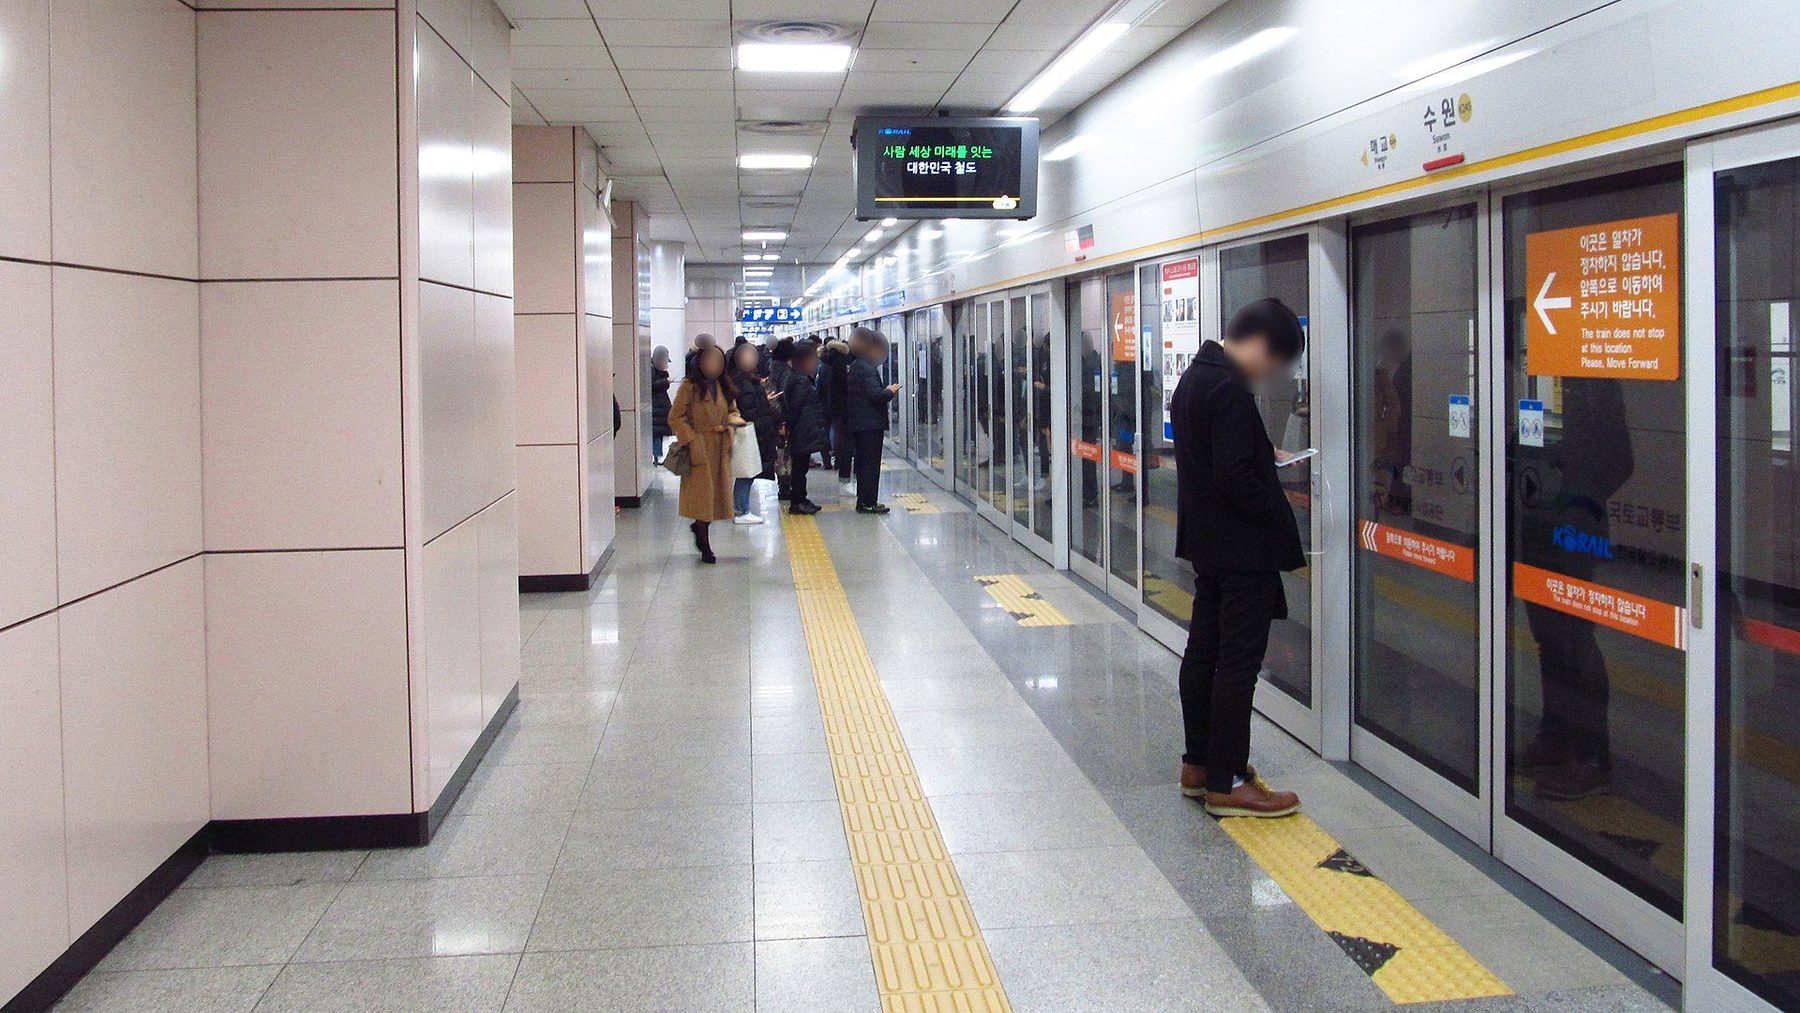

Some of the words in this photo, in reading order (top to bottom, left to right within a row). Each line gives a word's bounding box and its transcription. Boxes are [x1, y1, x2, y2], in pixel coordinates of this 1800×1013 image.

[1424, 97, 1456, 132] 수원
[883, 145, 906, 159] 사람
[909, 145, 931, 159] 세상
[934, 145, 968, 159] 미래를
[970, 145, 993, 159] 잇는
[907, 161, 952, 175] 대한민국
[954, 161, 977, 175] 철도
[1580, 231, 1608, 252] 이곳은
[1612, 228, 1642, 249] 열차가
[1580, 254, 1617, 276] 정차하지
[1621, 249, 1666, 271] 않습니다.
[1580, 277, 1617, 298] 앞쪽으로
[1622, 274, 1663, 295] 이동하여
[1580, 300, 1608, 319] 주시기
[1581, 327, 1593, 339] The
[1596, 327, 1611, 339] train
[1613, 327, 1631, 339] does
[1632, 328, 1646, 339] not
[1648, 328, 1665, 340] stop
[1581, 344, 1588, 353] at
[1590, 342, 1602, 353] this
[1604, 342, 1632, 354] location
[1607, 357, 1626, 369] Move
[1628, 357, 1659, 370] Forward
[1553, 525, 1613, 561] KORAIL
